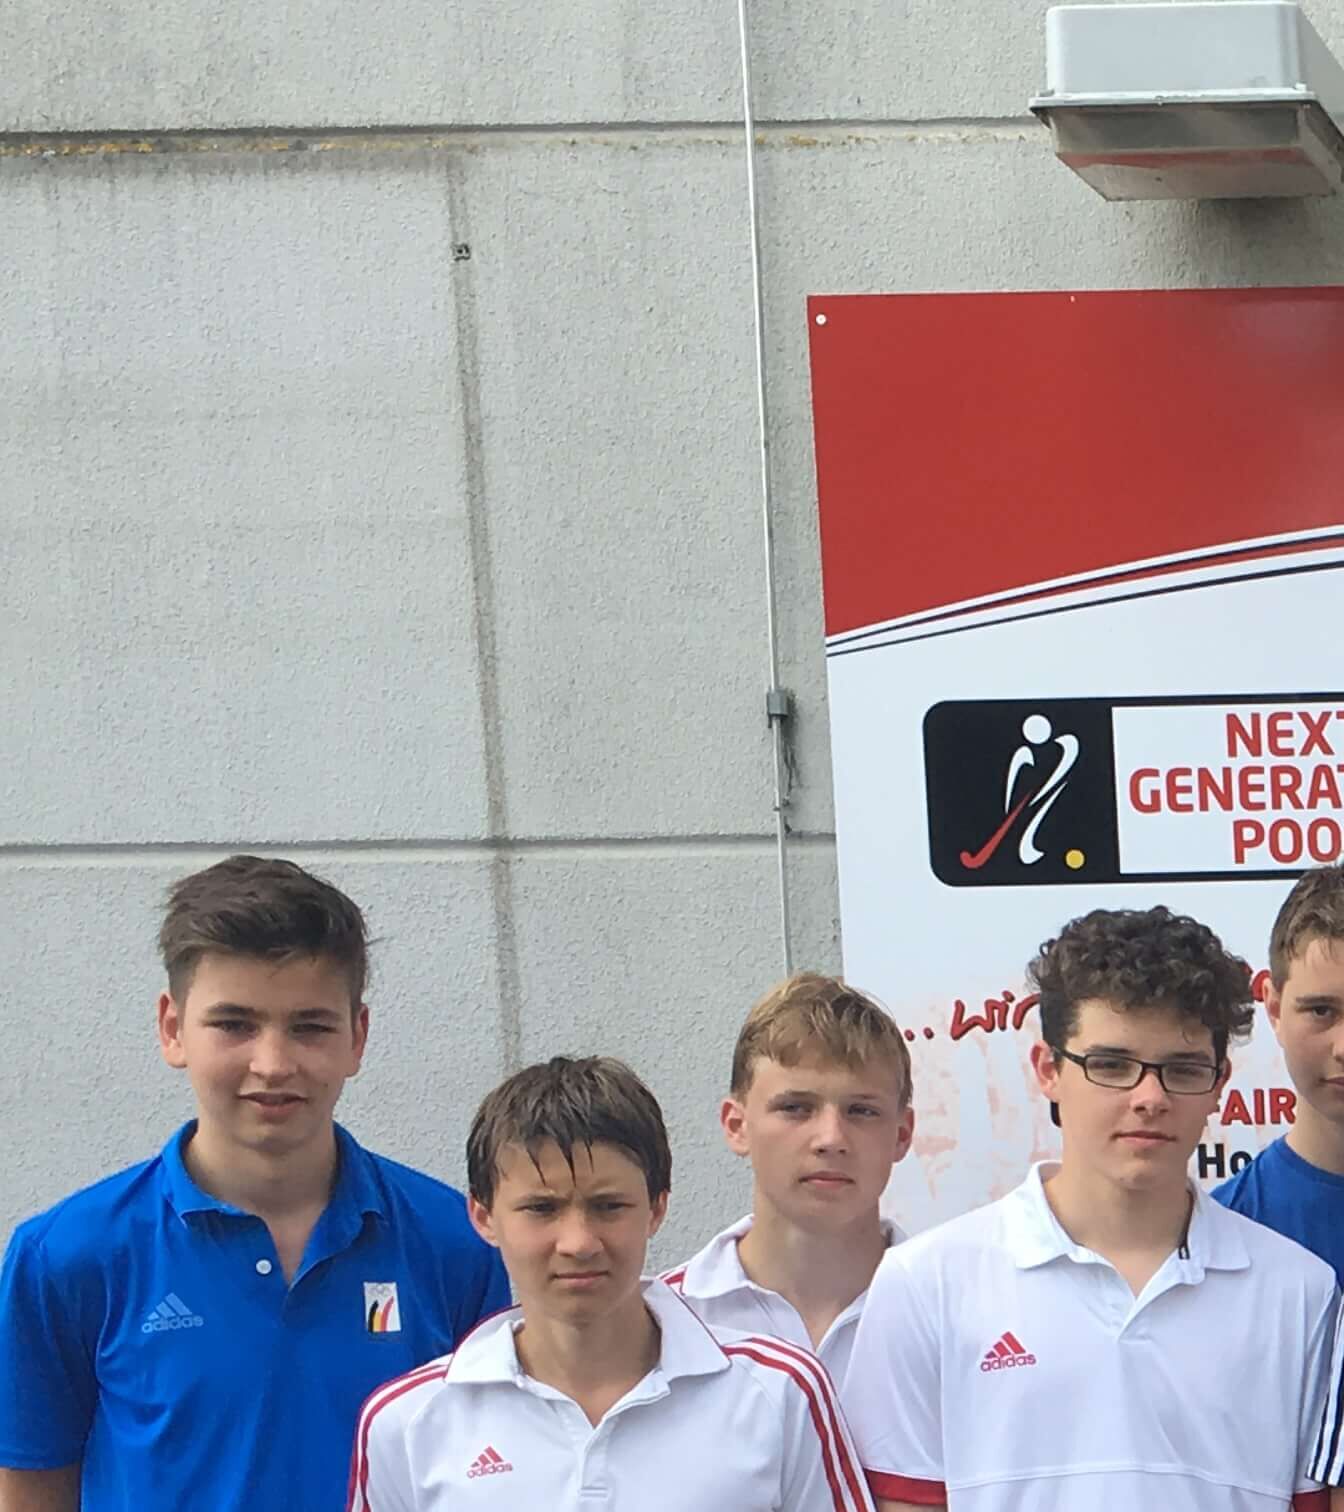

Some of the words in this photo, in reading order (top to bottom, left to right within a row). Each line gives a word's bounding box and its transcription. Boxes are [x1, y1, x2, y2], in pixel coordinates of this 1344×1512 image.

[141, 1314, 204, 1334] adidas
[979, 1353, 1037, 1373] adidas
[466, 1461, 514, 1479] adidas
